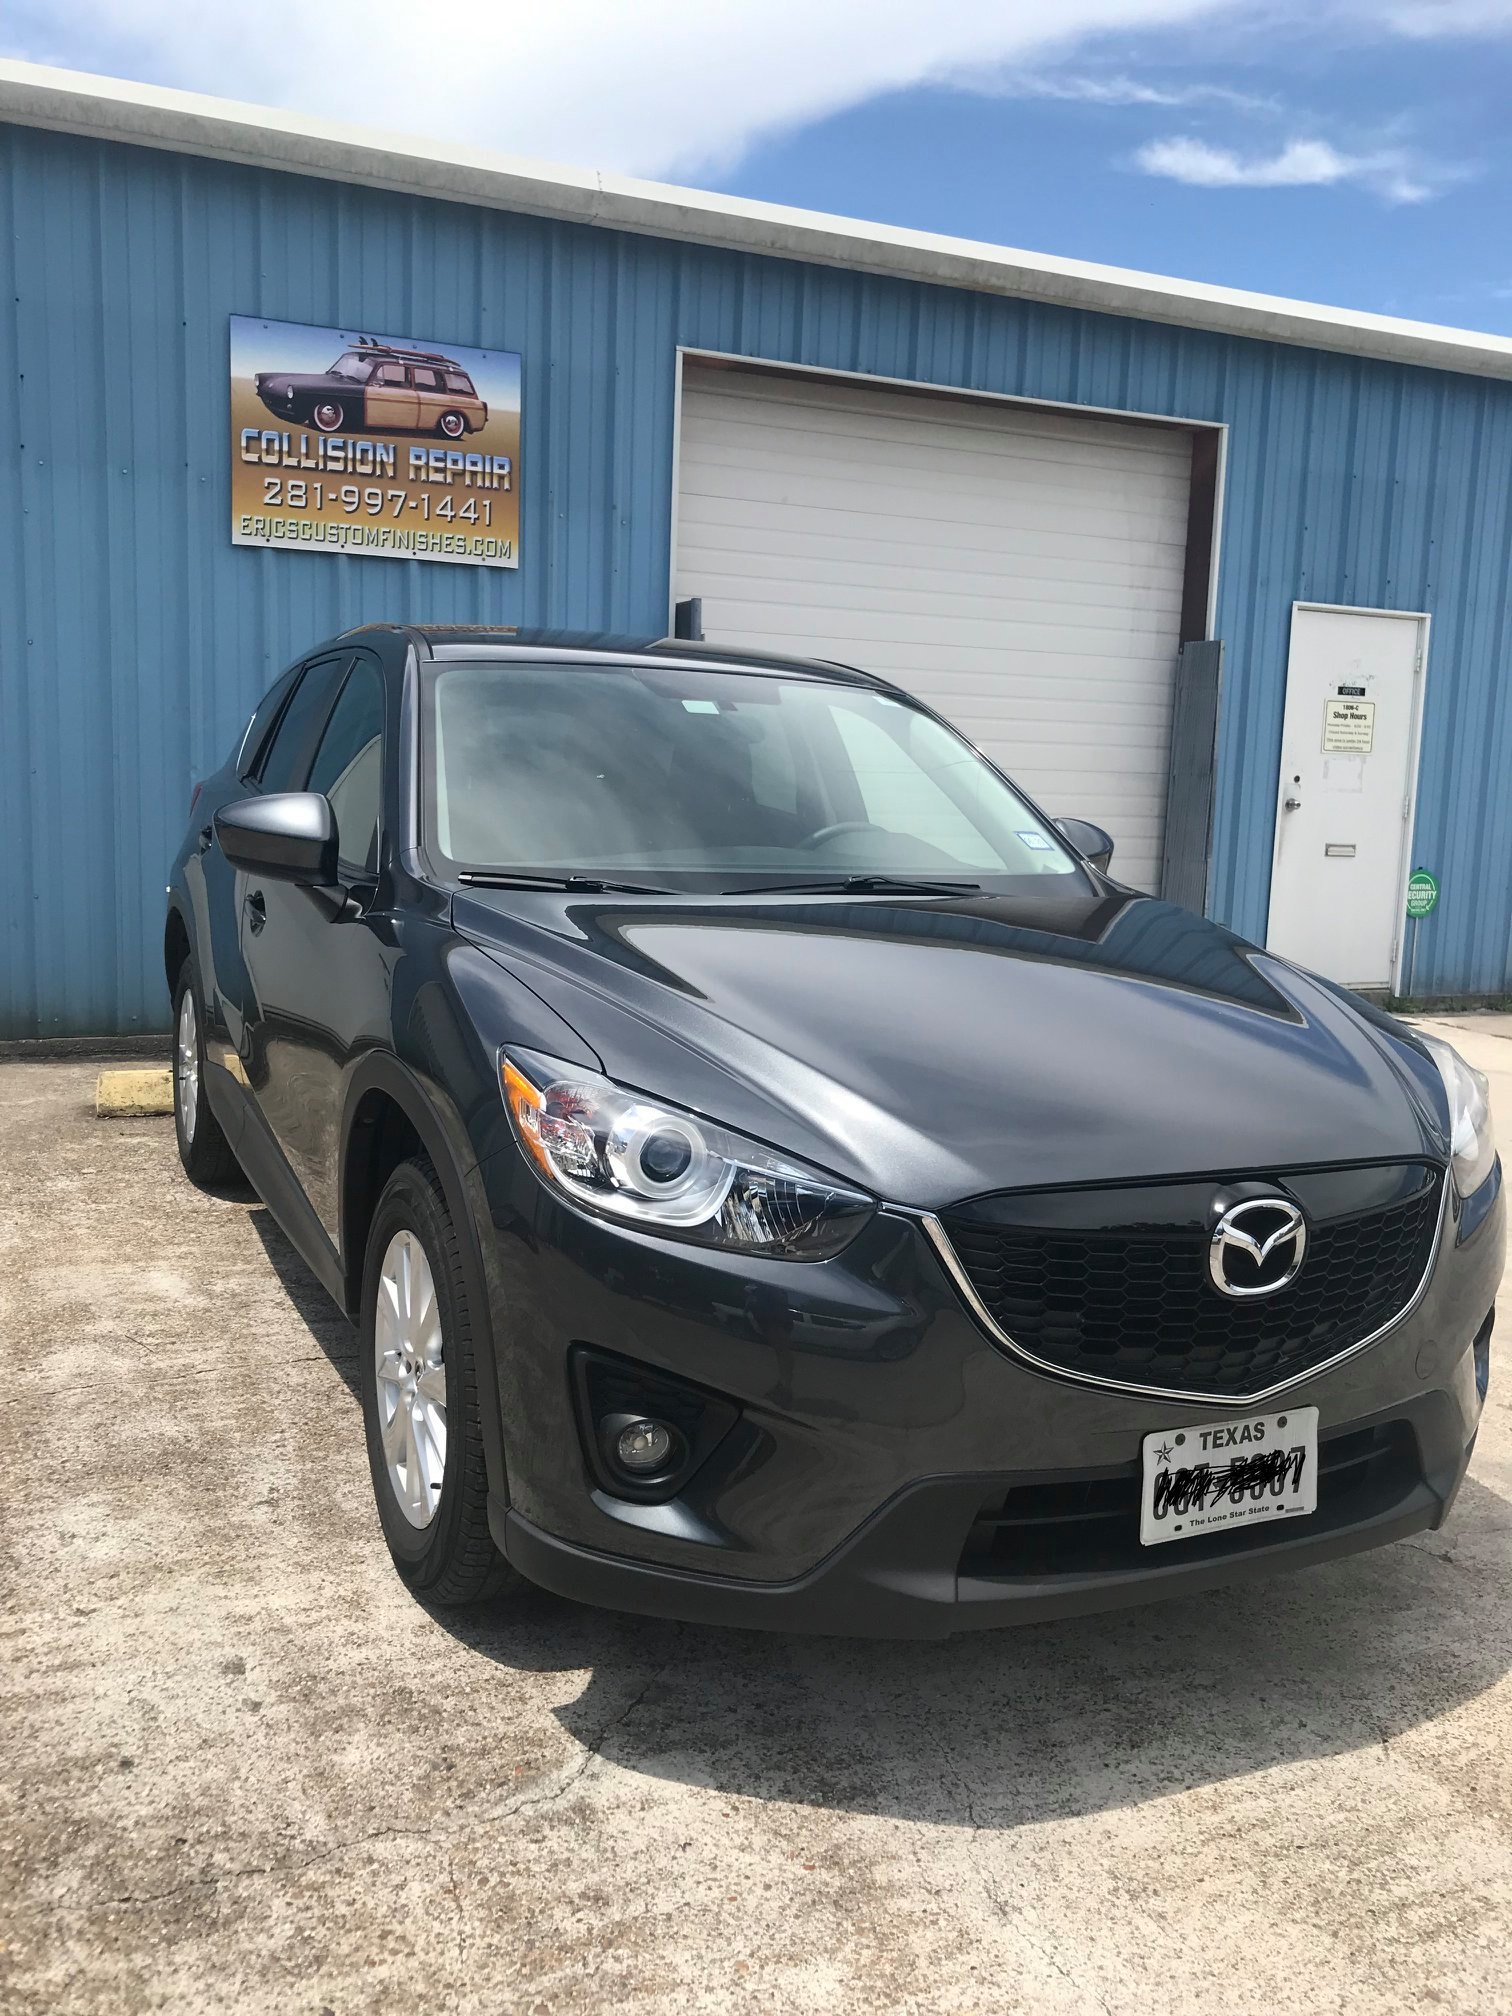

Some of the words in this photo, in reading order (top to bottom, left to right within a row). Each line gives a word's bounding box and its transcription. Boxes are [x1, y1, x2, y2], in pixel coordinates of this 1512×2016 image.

[240, 428, 396, 478] COLLISION
[408, 447, 512, 491] REPAIR
[263, 477, 492, 527] 281-997-1441
[240, 515, 512, 559] ERICSCUSTOMFINISHES.COM
[1333, 711, 1348, 720] Shop
[1350, 712, 1367, 720] Hours
[1408, 891, 1437, 899] ECURITY
[1199, 1421, 1265, 1450] TEXAS
[1190, 1518, 1205, 1527] The
[1207, 1514, 1228, 1523] Lone
[1229, 1509, 1247, 1519] Star
[1248, 1505, 1270, 1515] State
